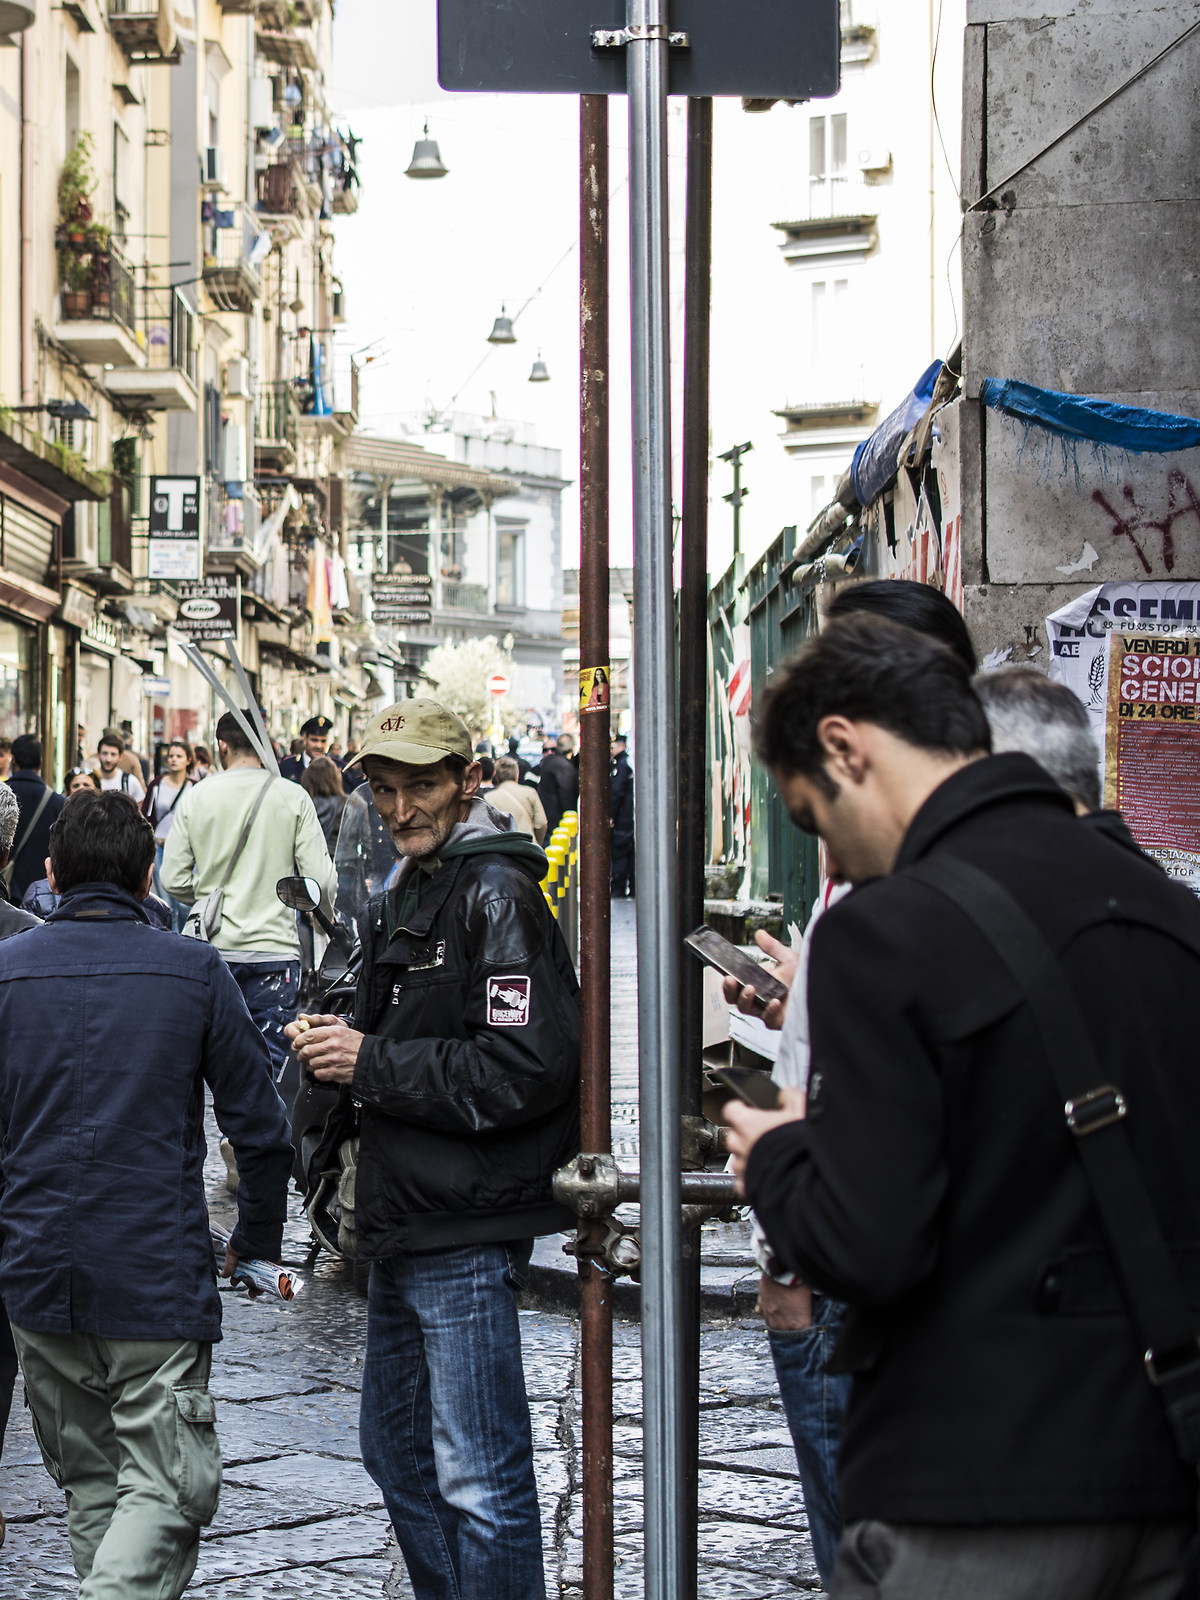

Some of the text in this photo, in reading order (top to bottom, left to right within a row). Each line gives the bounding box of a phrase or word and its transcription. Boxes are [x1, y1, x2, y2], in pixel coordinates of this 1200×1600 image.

[155, 479, 197, 531] T
[1123, 637, 1189, 655] VENERDÌ
[1119, 702, 1134, 717] DI
[1138, 703, 1156, 718] 24
[1161, 705, 1195, 720] ORE
